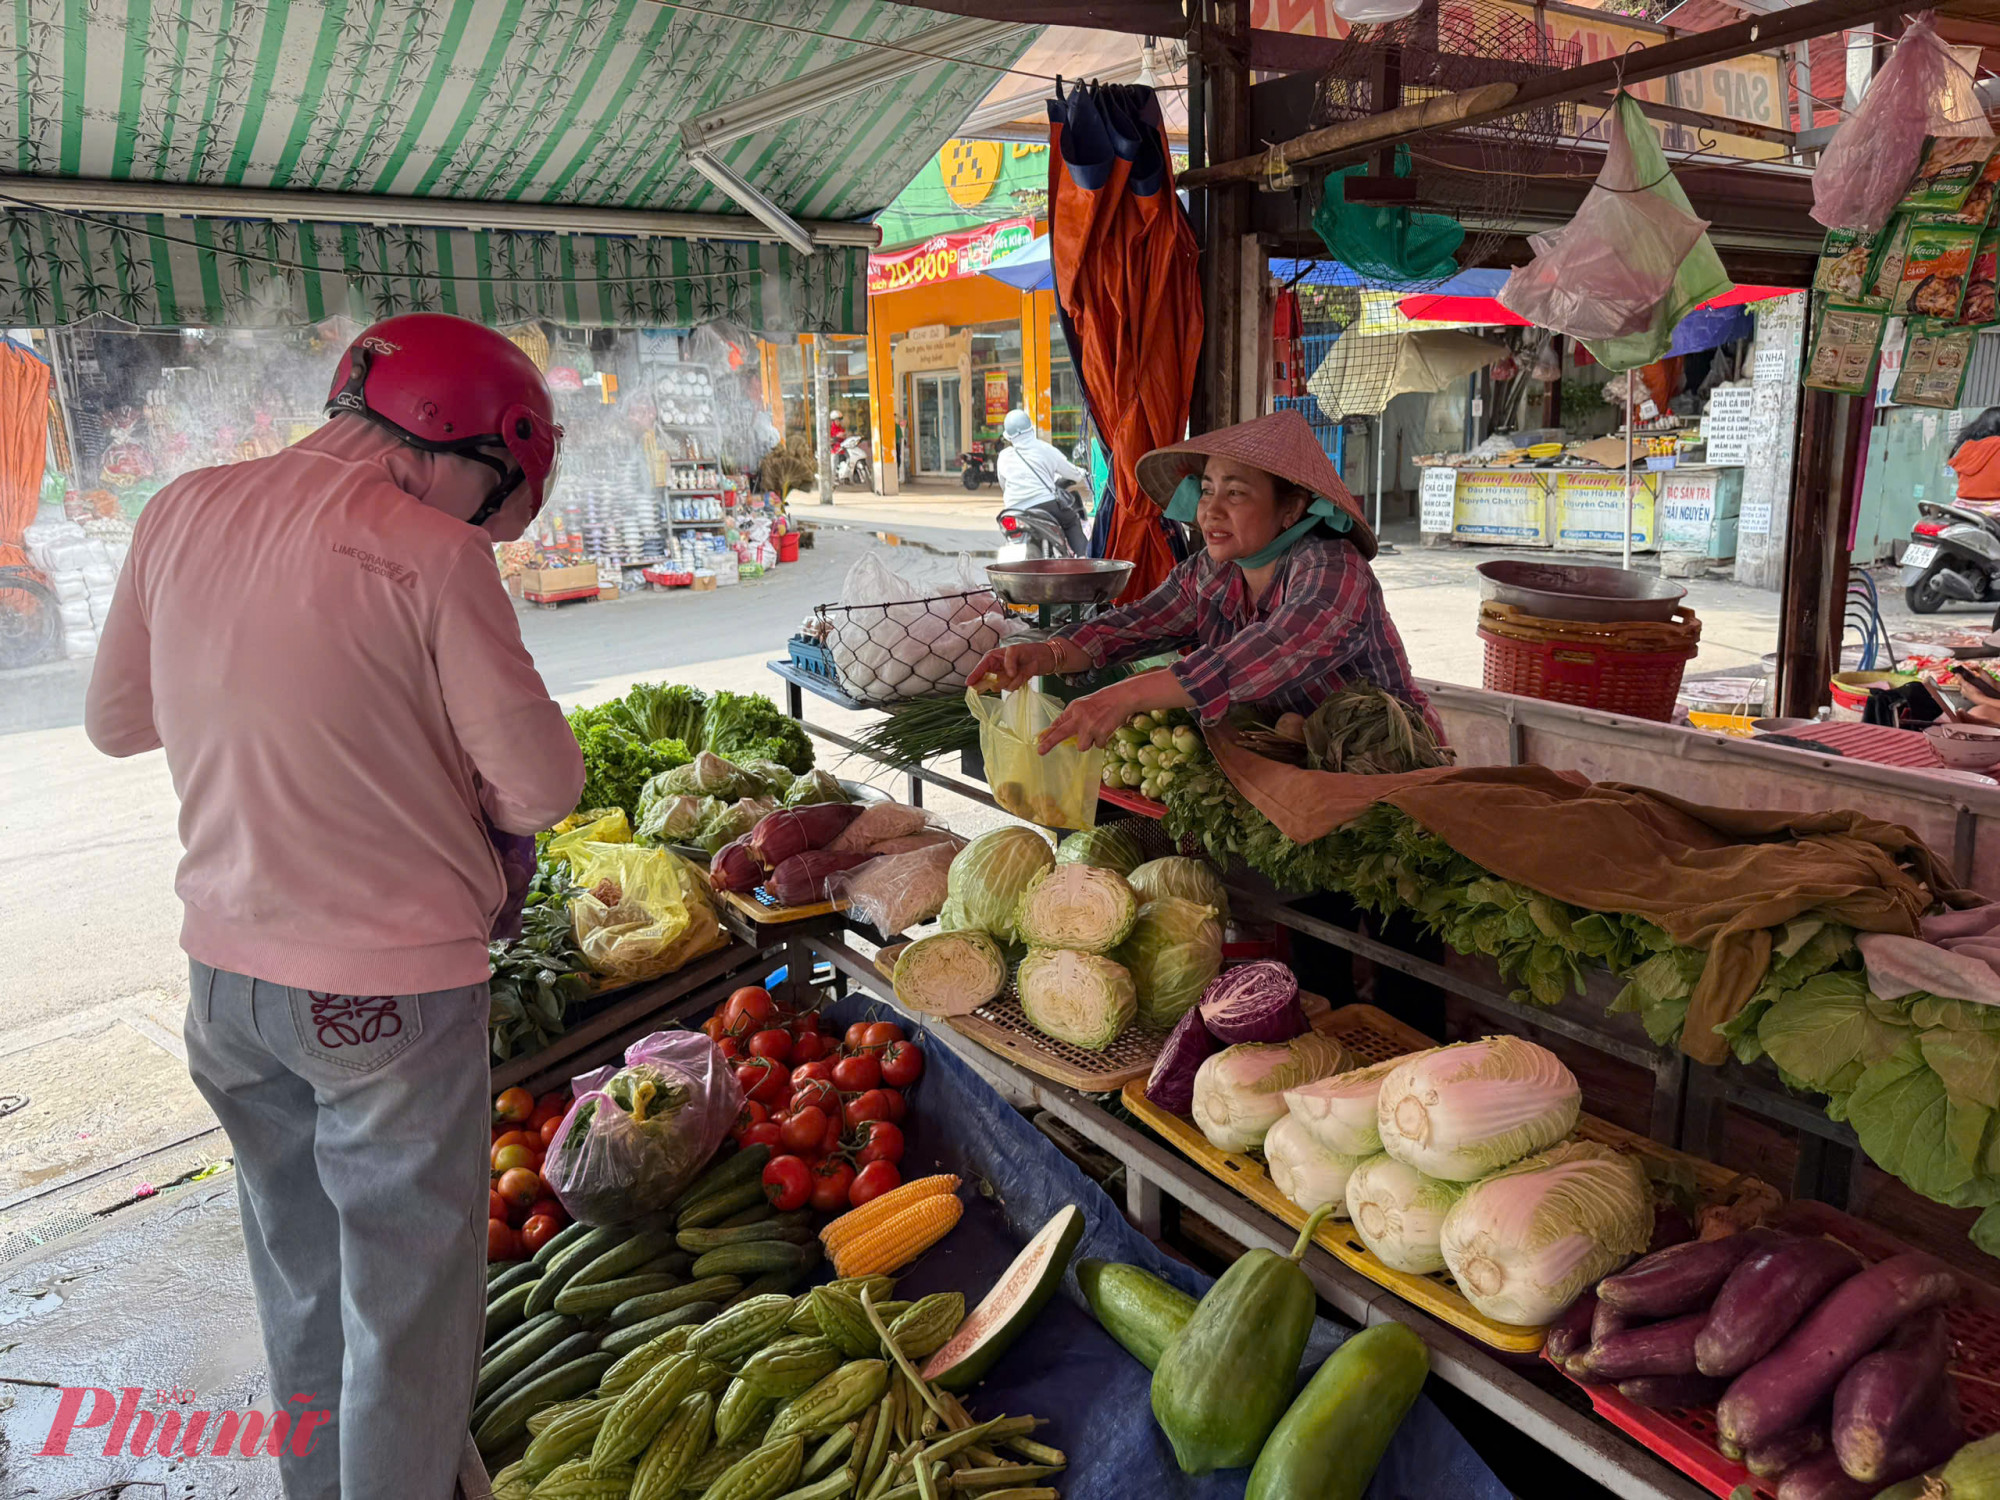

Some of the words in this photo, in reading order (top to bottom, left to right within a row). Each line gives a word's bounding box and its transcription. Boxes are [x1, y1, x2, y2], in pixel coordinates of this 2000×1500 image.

[1914, 244, 1940, 256] Knorr
[1460, 497, 1490, 506] Nguyên
[1492, 496, 1512, 505] Chất
[1564, 500, 1595, 510] Nguyên
[1598, 500, 1618, 509] Chất
[1680, 504, 1710, 521] NGUYÊN
[332, 543, 404, 575] LIMEORANGE
